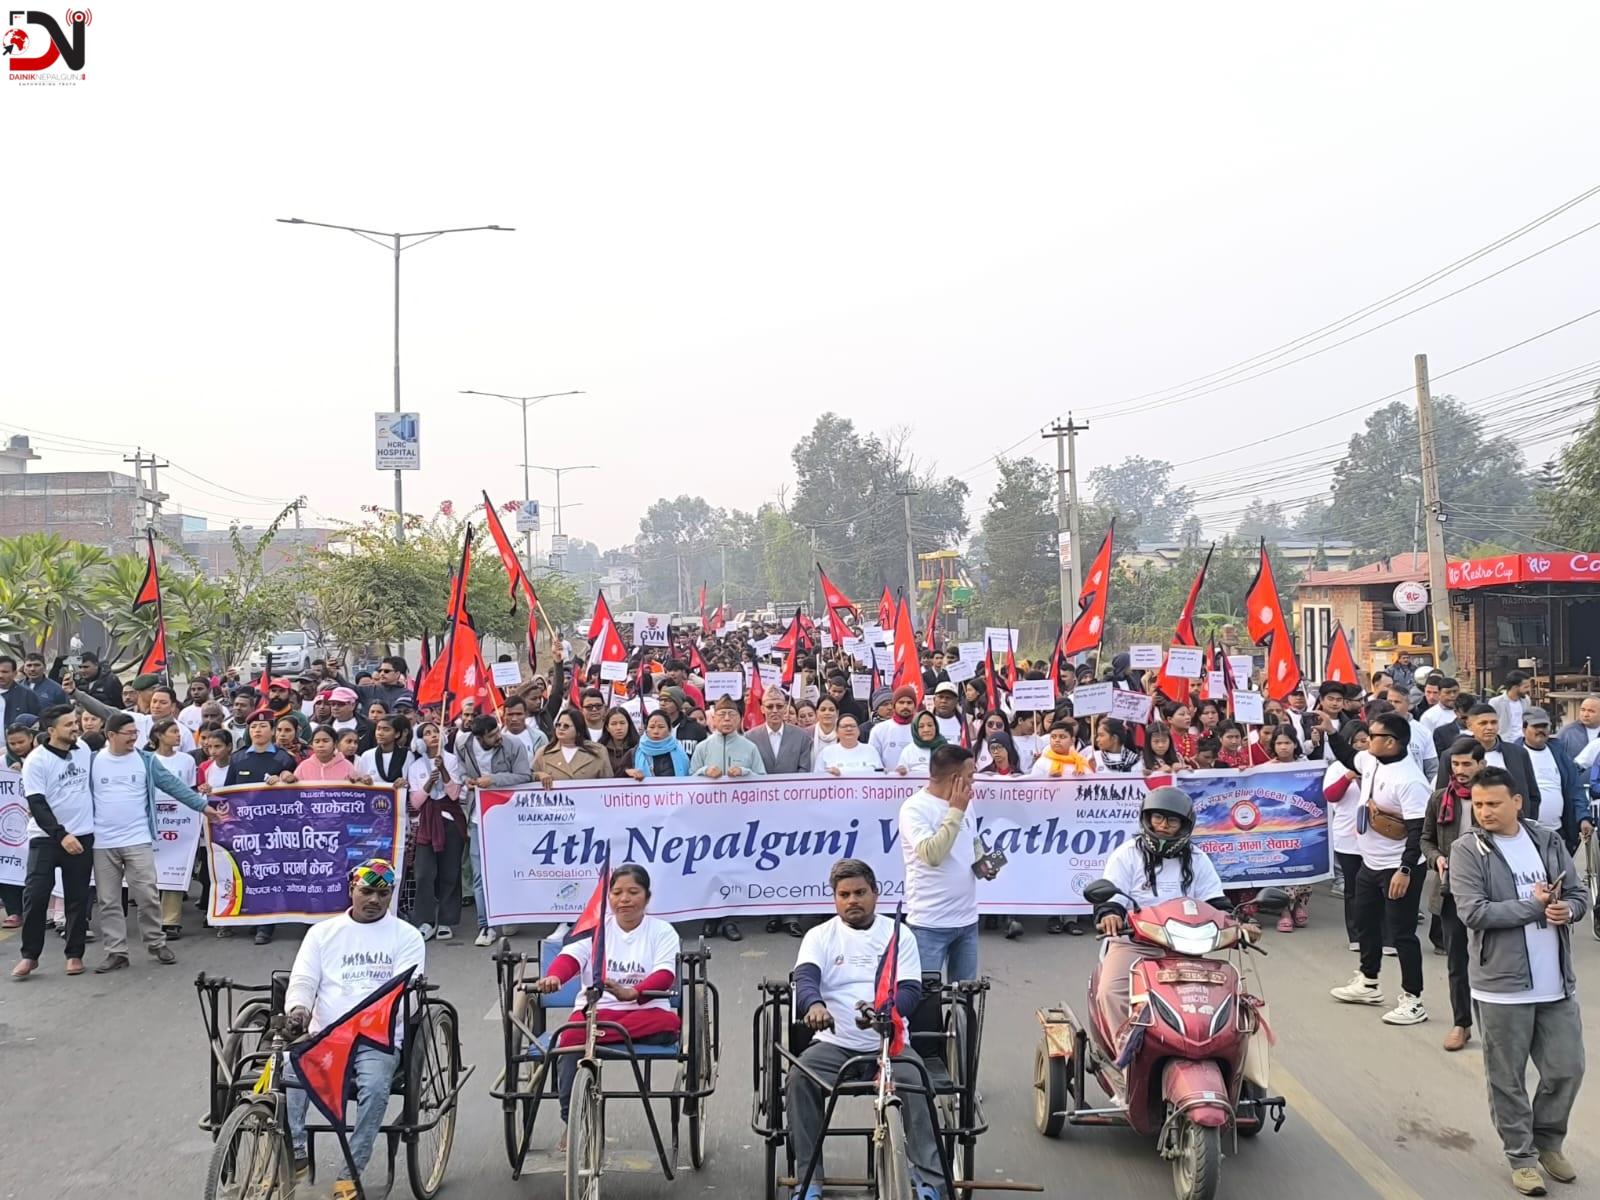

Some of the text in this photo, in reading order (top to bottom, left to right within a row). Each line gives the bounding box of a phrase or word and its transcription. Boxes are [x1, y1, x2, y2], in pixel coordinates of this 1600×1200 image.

[377, 448, 417, 457] HOSPITAL
[1460, 561, 1494, 582] Restro
[1494, 561, 1513, 582] Cup
[640, 630, 665, 641] GVN
[655, 791, 684, 806] with
[688, 789, 727, 805] Youth
[731, 788, 780, 805] Against
[783, 785, 858, 801] corruption:
[862, 785, 914, 802] Shaping
[1256, 787, 1287, 801] Ocean
[1291, 794, 1323, 817] Shelter
[518, 813, 576, 822] WALKATHON
[1076, 808, 1140, 819] WALKATHO
[532, 826, 609, 865] 4th
[622, 817, 859, 876] Nepalgunj
[513, 869, 525, 878] In
[528, 868, 592, 878] Association
[720, 884, 742, 900] 9th
[748, 882, 836, 899] Decemb
